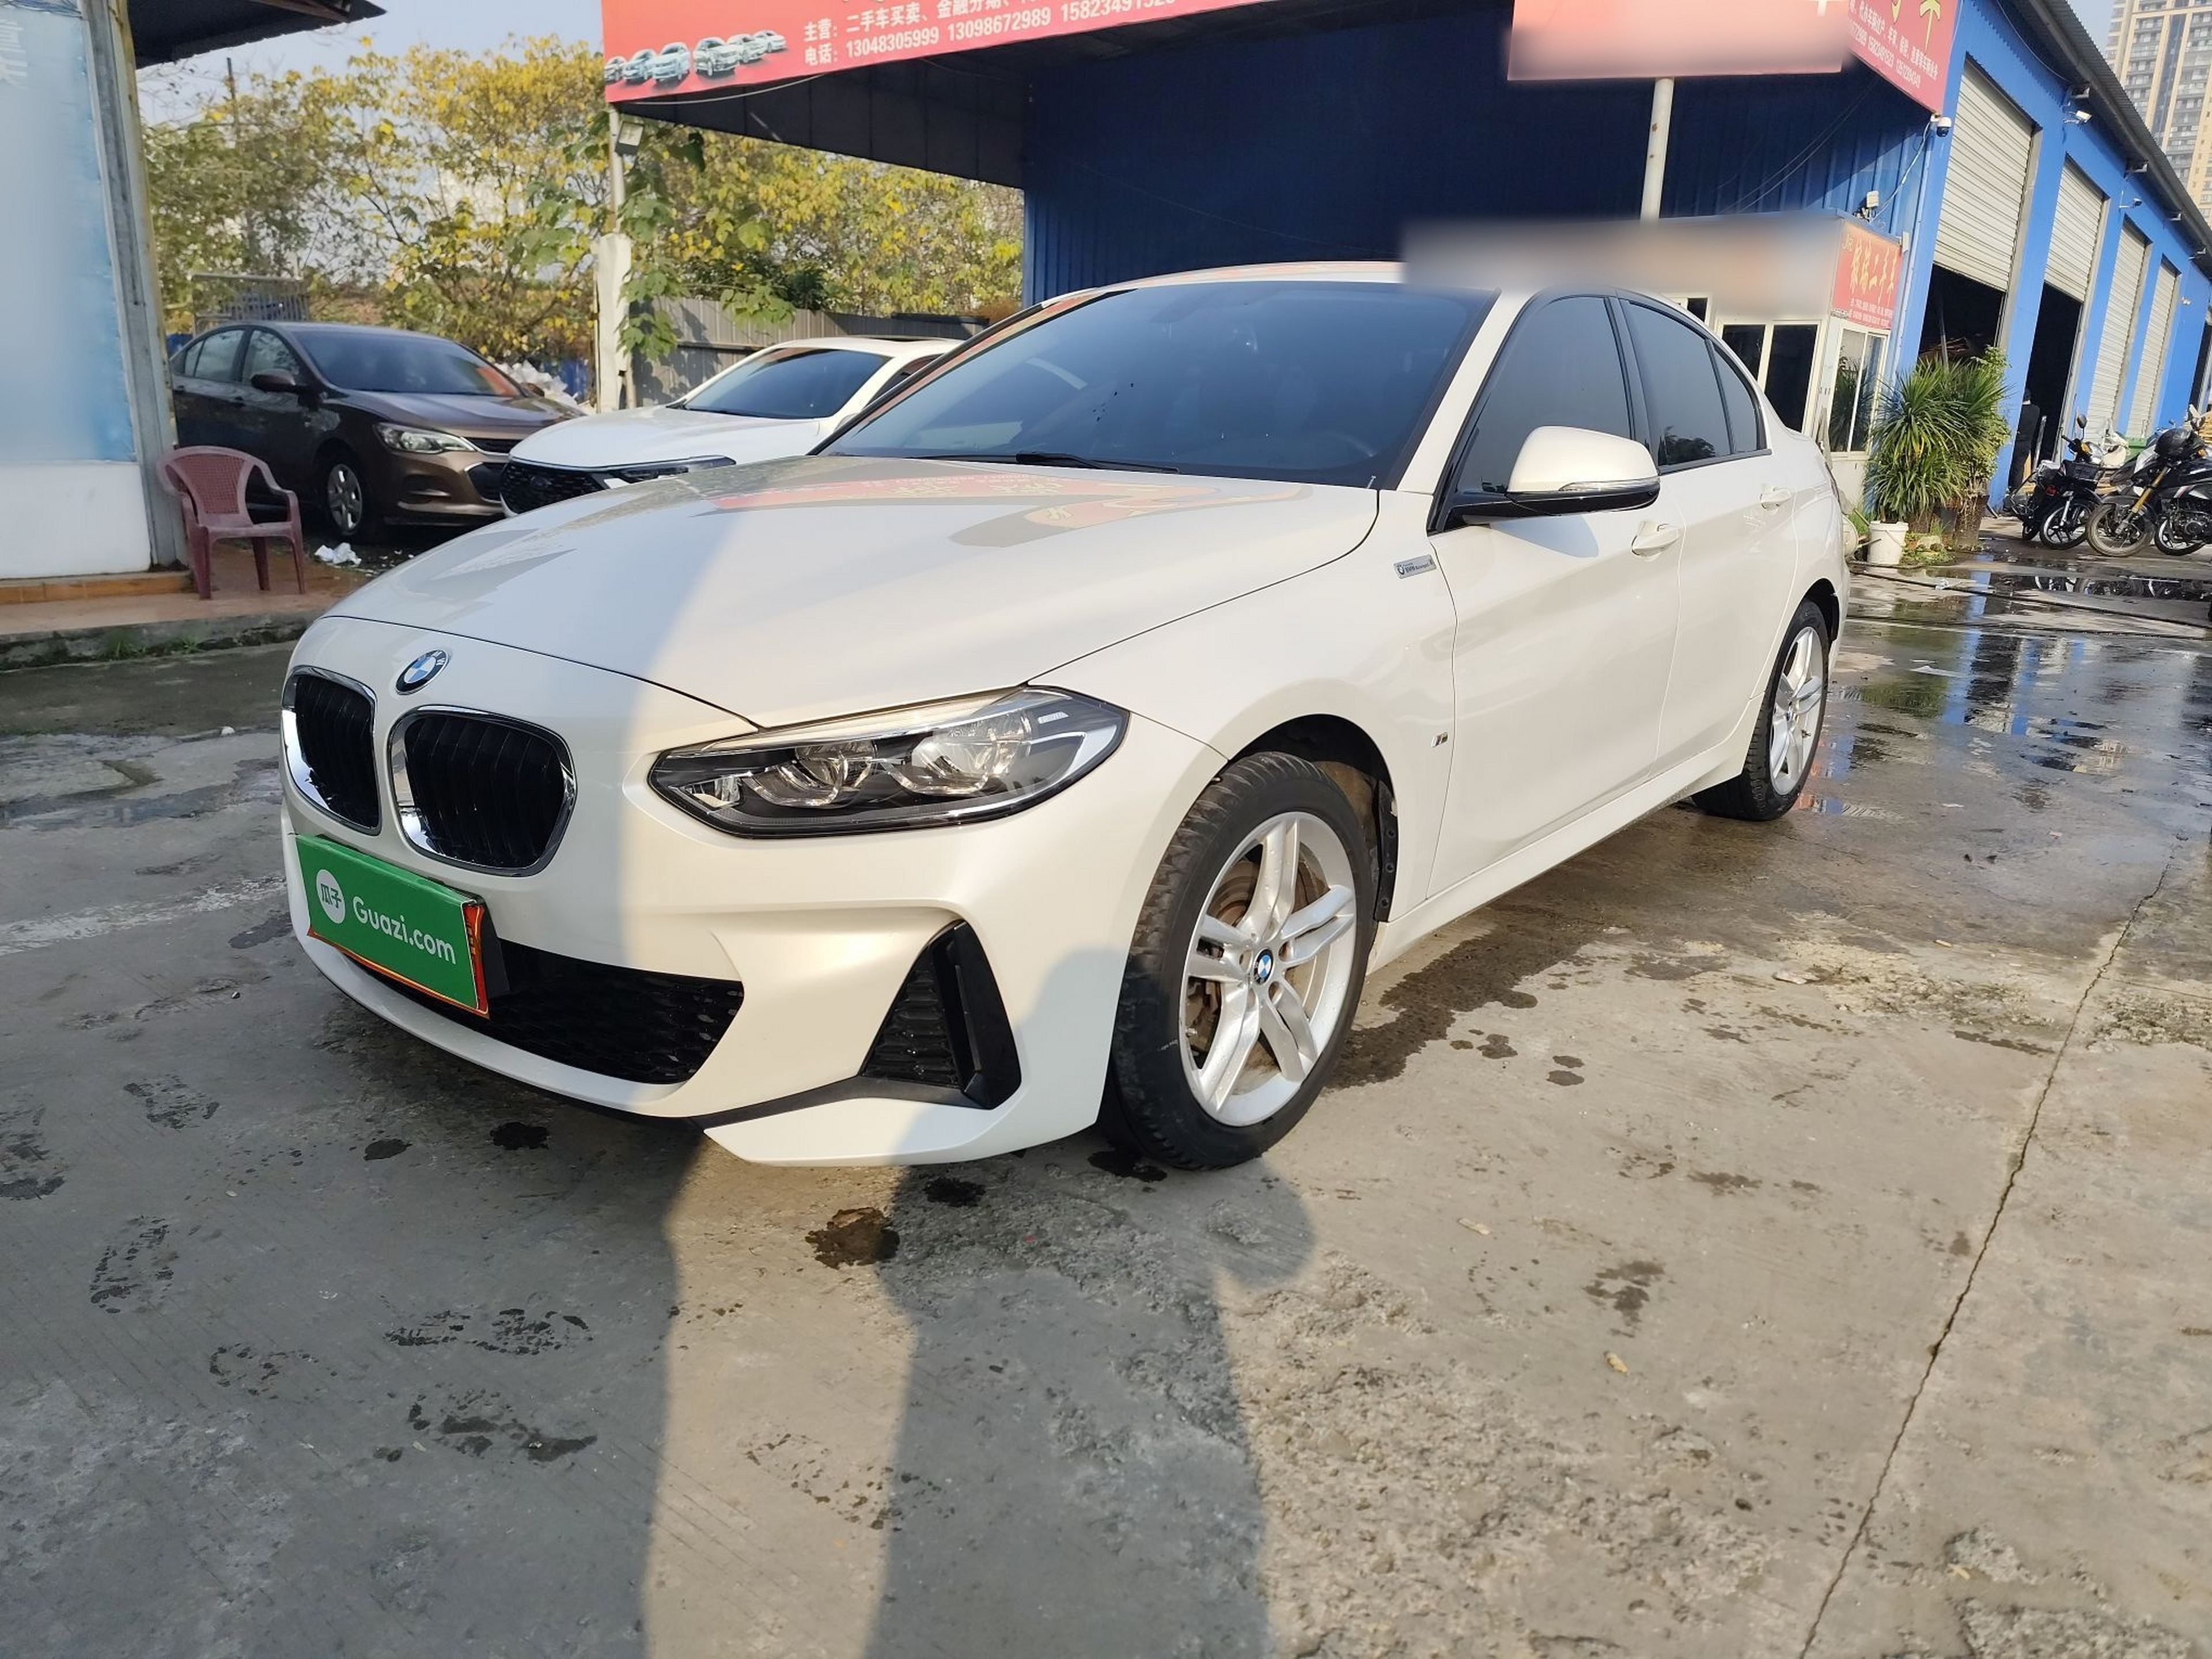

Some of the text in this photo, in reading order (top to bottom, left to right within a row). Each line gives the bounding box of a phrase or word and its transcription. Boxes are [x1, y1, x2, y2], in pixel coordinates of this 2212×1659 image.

[846, 26, 939, 58] 13048305999
[948, 6, 1051, 41] 13098672989
[1060, 0, 1176, 22] 15823491
[321, 883, 342, 909] 瓜子
[353, 896, 456, 965] Guazi.com
